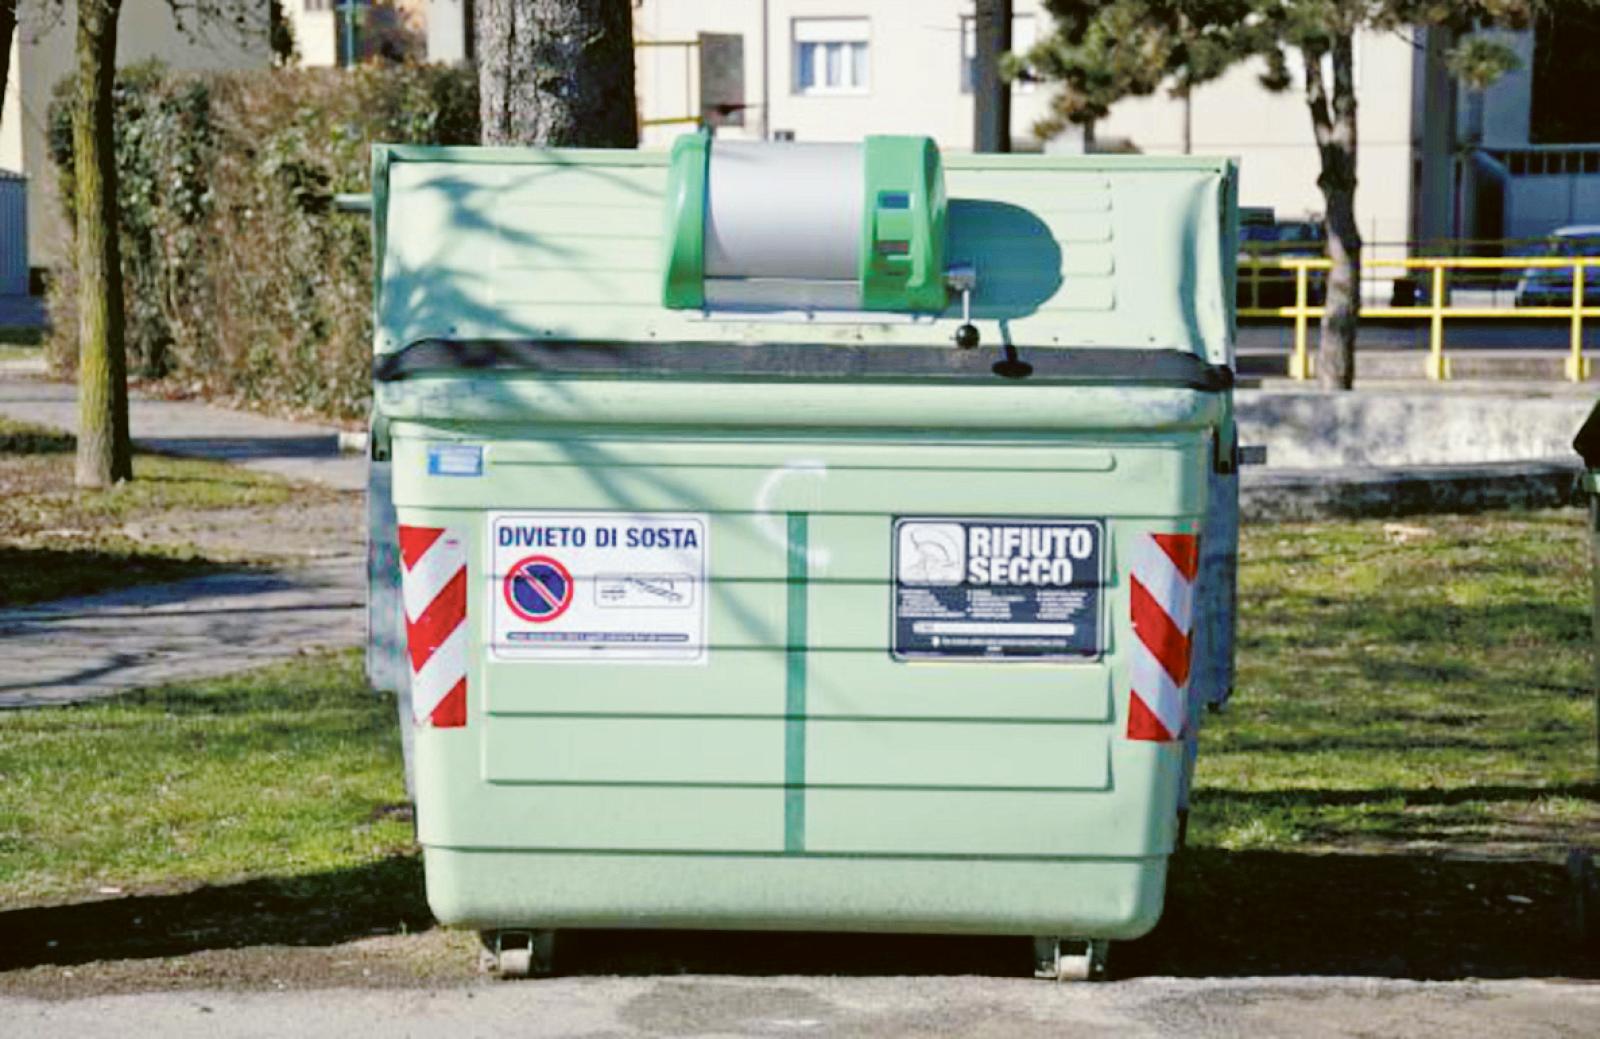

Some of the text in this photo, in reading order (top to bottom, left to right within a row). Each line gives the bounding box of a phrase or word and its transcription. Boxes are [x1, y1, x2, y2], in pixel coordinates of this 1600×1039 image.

[499, 526, 698, 549] DIVIETO DI SOSTA
[968, 526, 1093, 559] RIFIUTO
[968, 557, 1073, 586] SECCO
